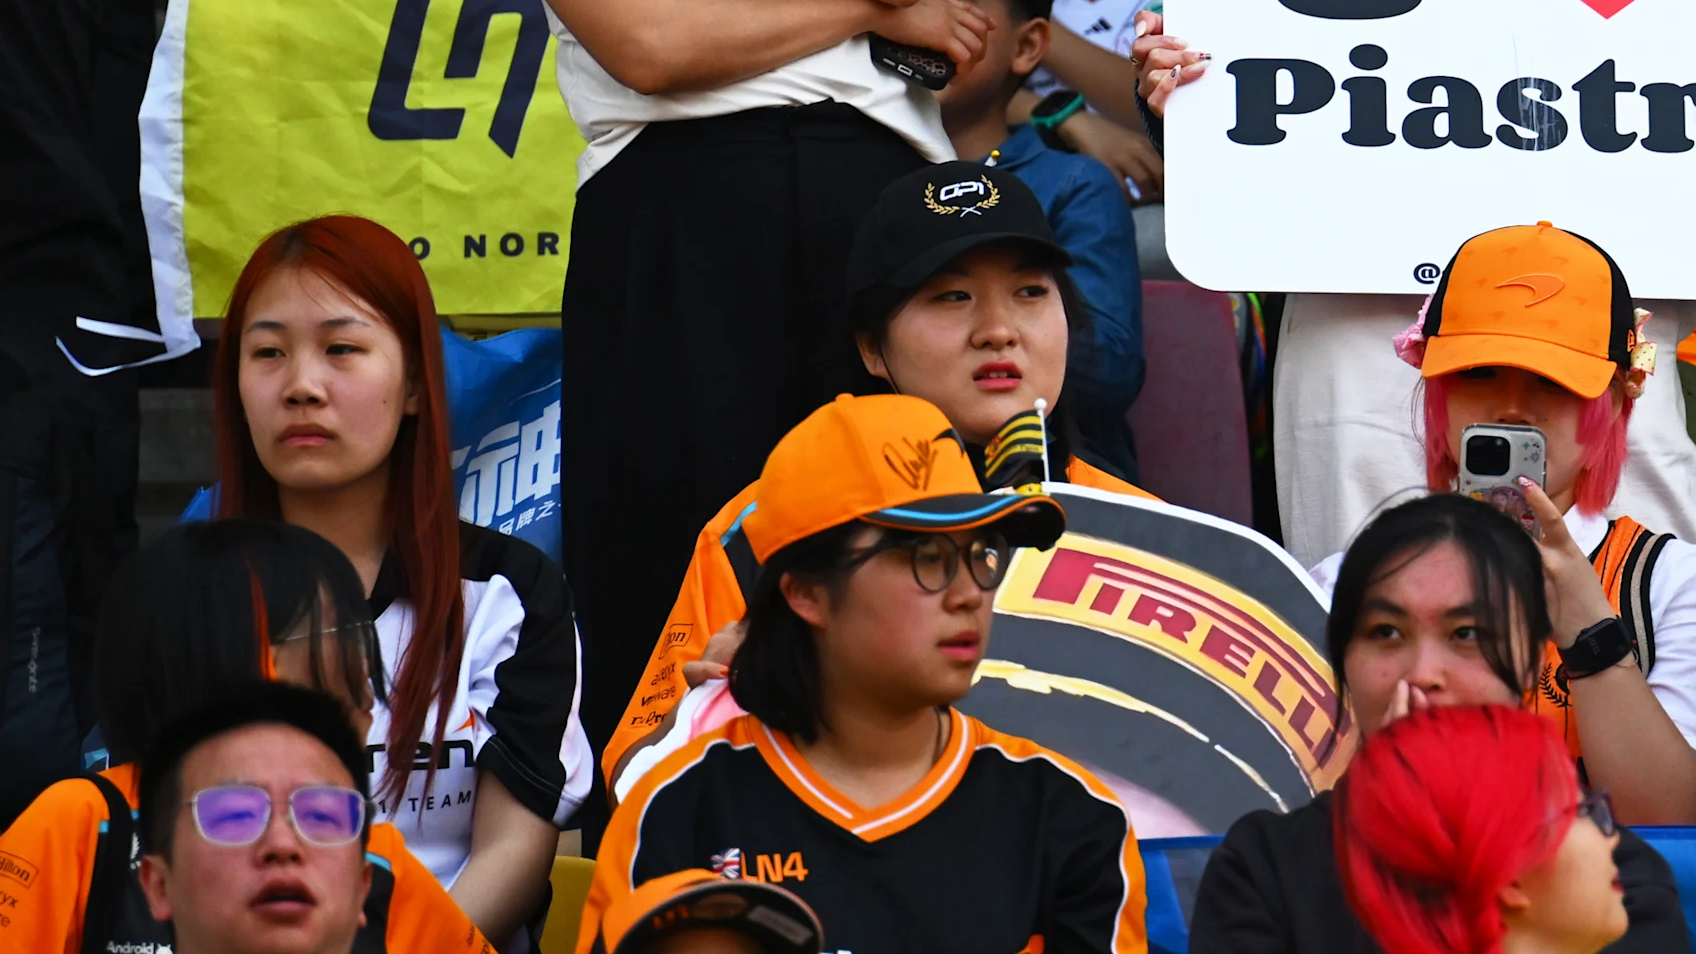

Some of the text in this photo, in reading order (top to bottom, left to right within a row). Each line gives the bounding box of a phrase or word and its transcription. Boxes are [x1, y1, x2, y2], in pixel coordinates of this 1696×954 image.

[498, 499, 562, 536] 品牌之
[1032, 546, 1353, 771] PIRELLI
[408, 789, 472, 813] TEAM
[740, 851, 809, 883] LN4
